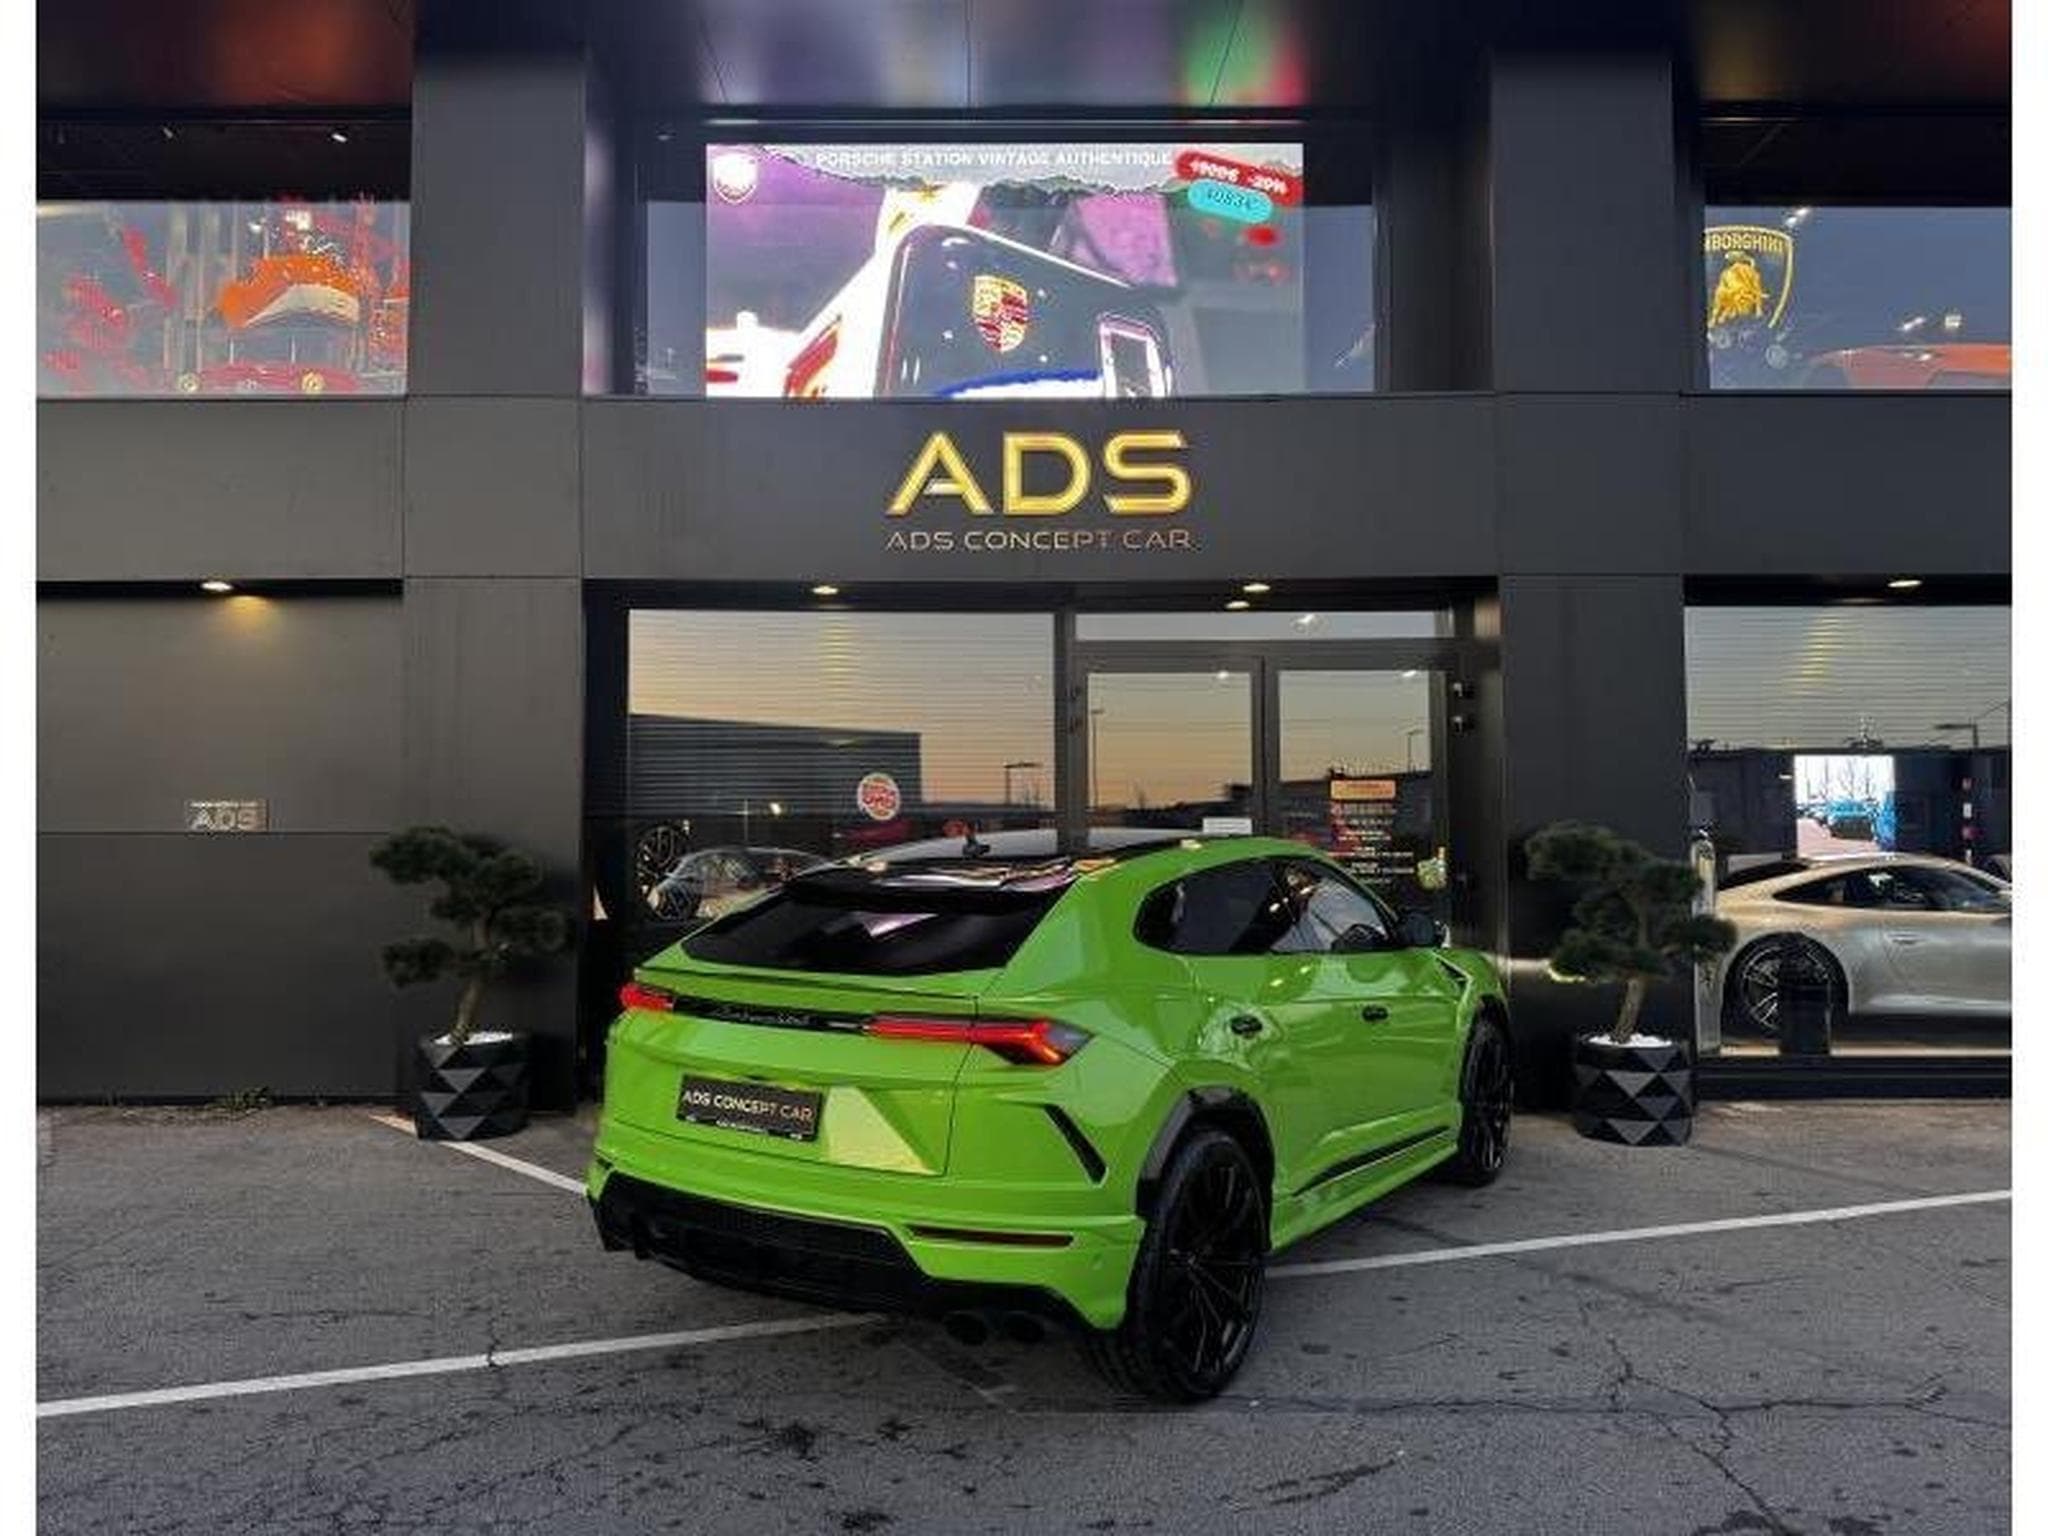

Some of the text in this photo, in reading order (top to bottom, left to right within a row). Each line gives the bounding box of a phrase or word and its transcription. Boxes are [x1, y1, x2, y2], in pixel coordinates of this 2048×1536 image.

[815, 151, 1172, 167] PORSCHE STATION VINTAGE AUTHENTIQUE
[885, 431, 1191, 516] ADS
[886, 529, 1193, 551] ADS CONCEPT CAR
[681, 1089, 813, 1122] ADS CONCEPT CAR
